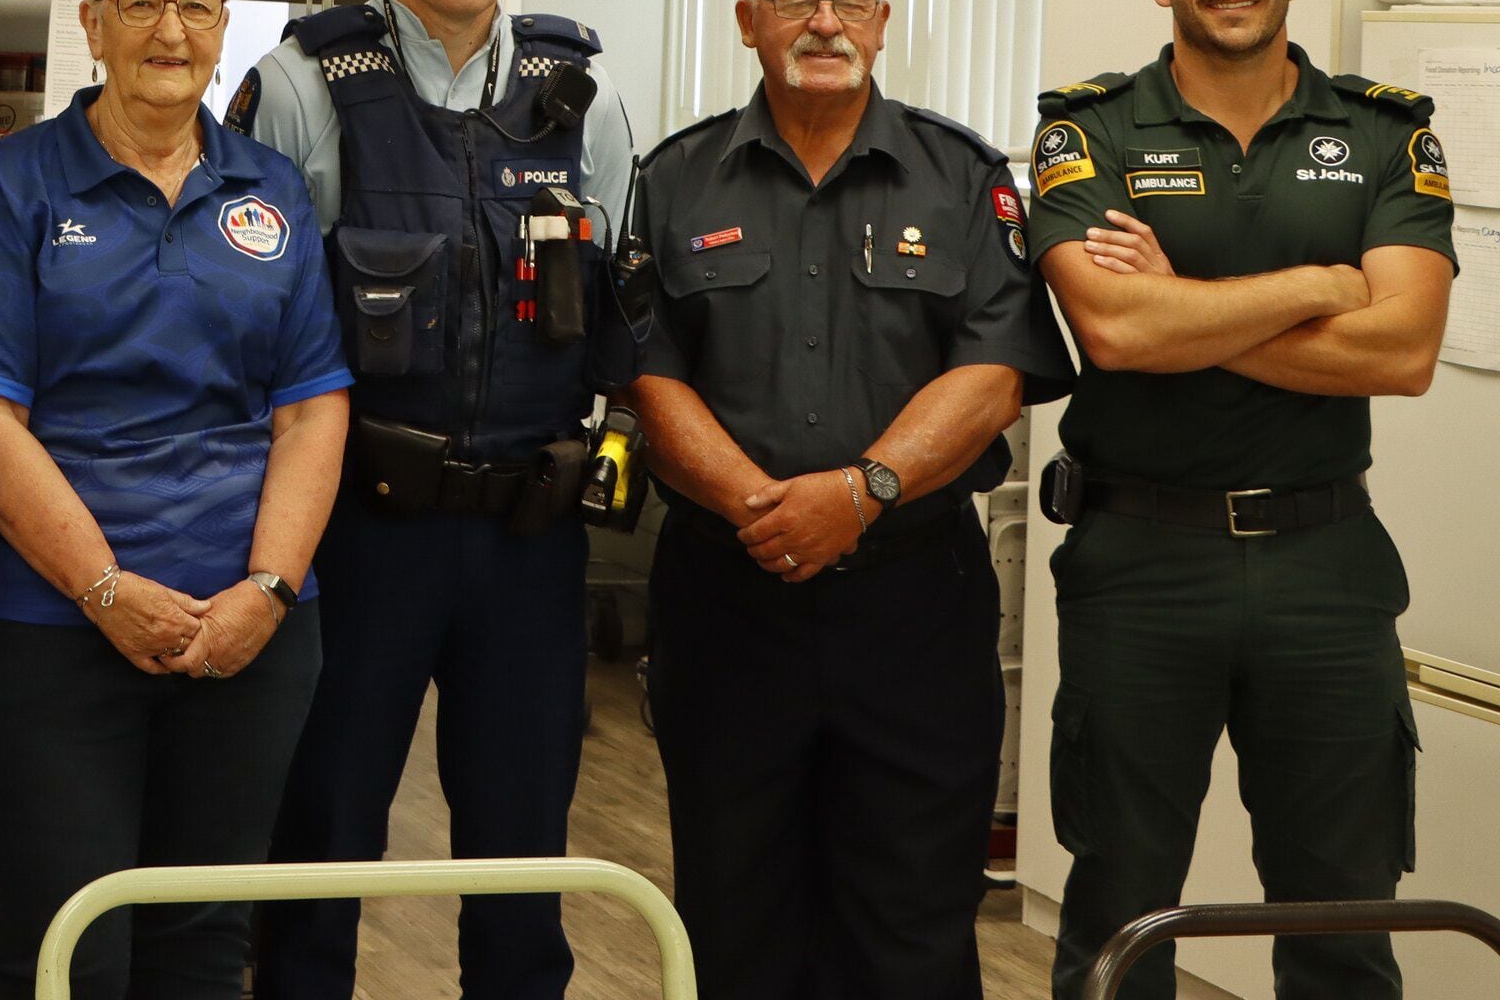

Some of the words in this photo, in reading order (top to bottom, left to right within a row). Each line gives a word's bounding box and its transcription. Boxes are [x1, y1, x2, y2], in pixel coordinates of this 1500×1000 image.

[1037, 161, 1048, 173] St
[1047, 151, 1081, 167] John
[1143, 153, 1179, 165] KURT
[524, 171, 568, 184] POLICE
[1042, 164, 1083, 186] AMBULANCE
[1296, 169, 1318, 181] St
[1319, 168, 1365, 184] John
[1135, 177, 1198, 190] AMBULANCE
[231, 228, 278, 240] Neighbourhood
[241, 234, 270, 245] Support
[52, 235, 97, 247] LEGEND
